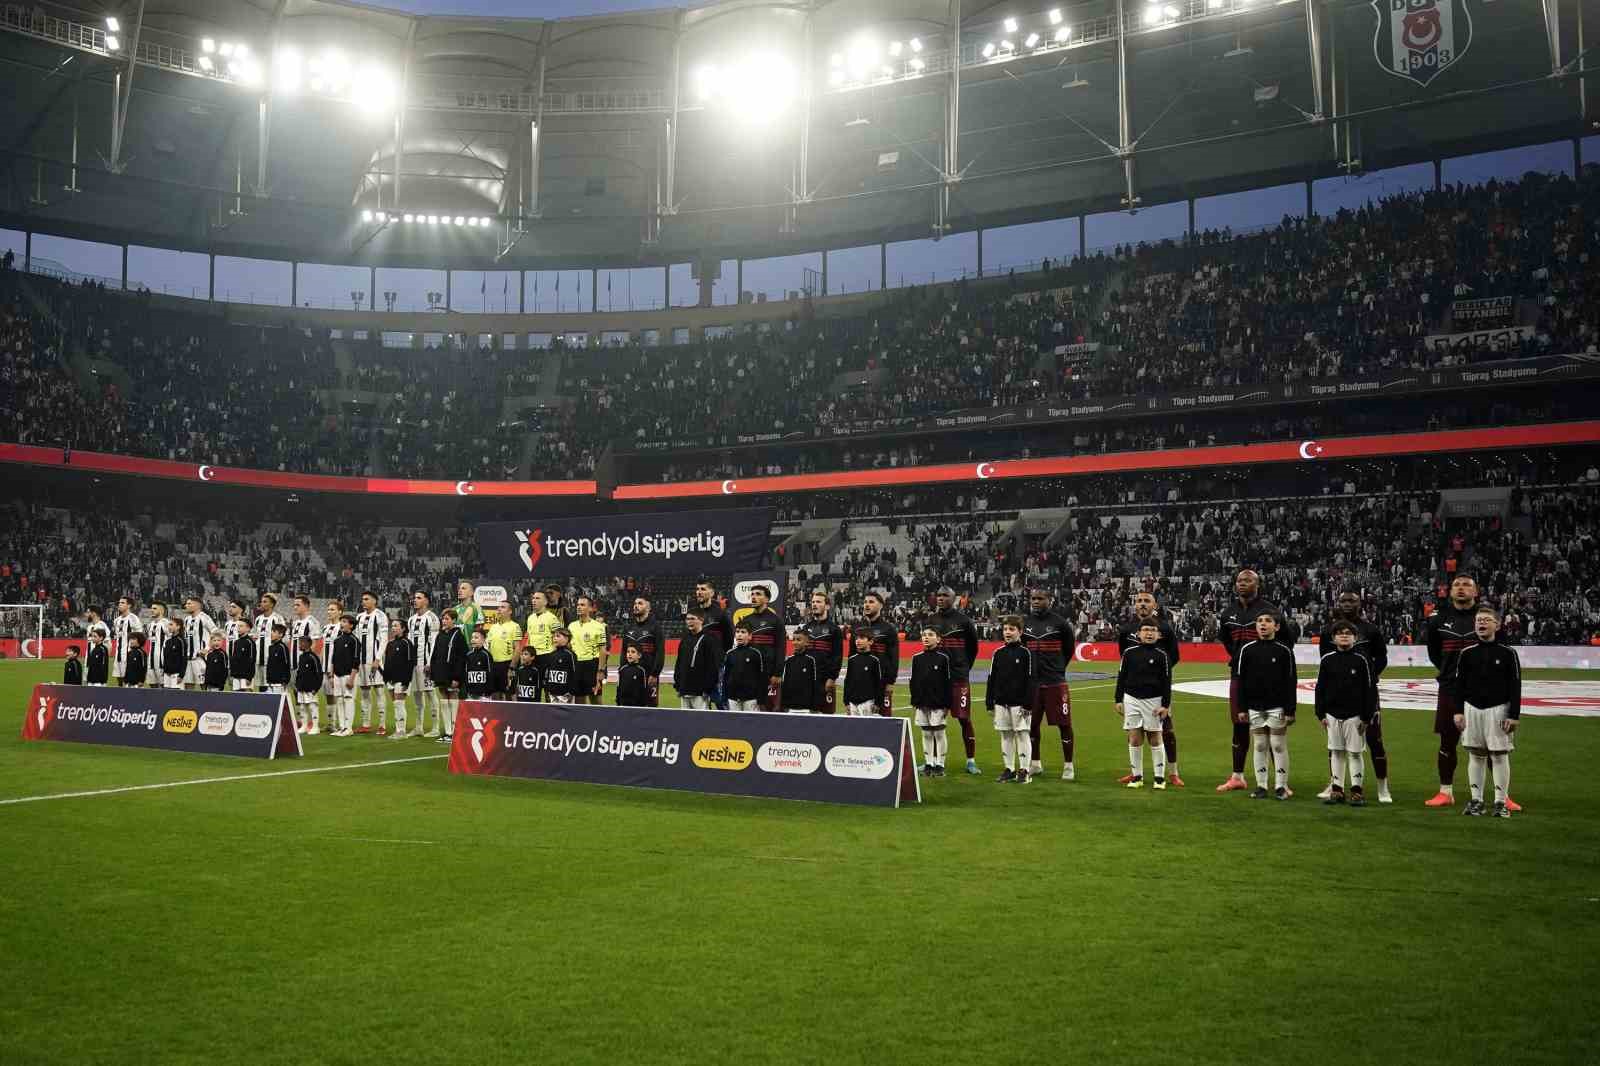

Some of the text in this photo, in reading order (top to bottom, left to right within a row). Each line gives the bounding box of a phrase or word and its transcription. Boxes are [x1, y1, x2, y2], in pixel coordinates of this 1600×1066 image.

[1400, 50, 1450, 71] 1903
[545, 530, 640, 561] trendyol
[960, 695, 968, 708] 3
[1062, 702, 1069, 715] 8
[57, 702, 112, 725] trendyol
[503, 725, 598, 757] trendyol
[768, 746, 813, 760] trendyol
[774, 759, 803, 769] yemek
